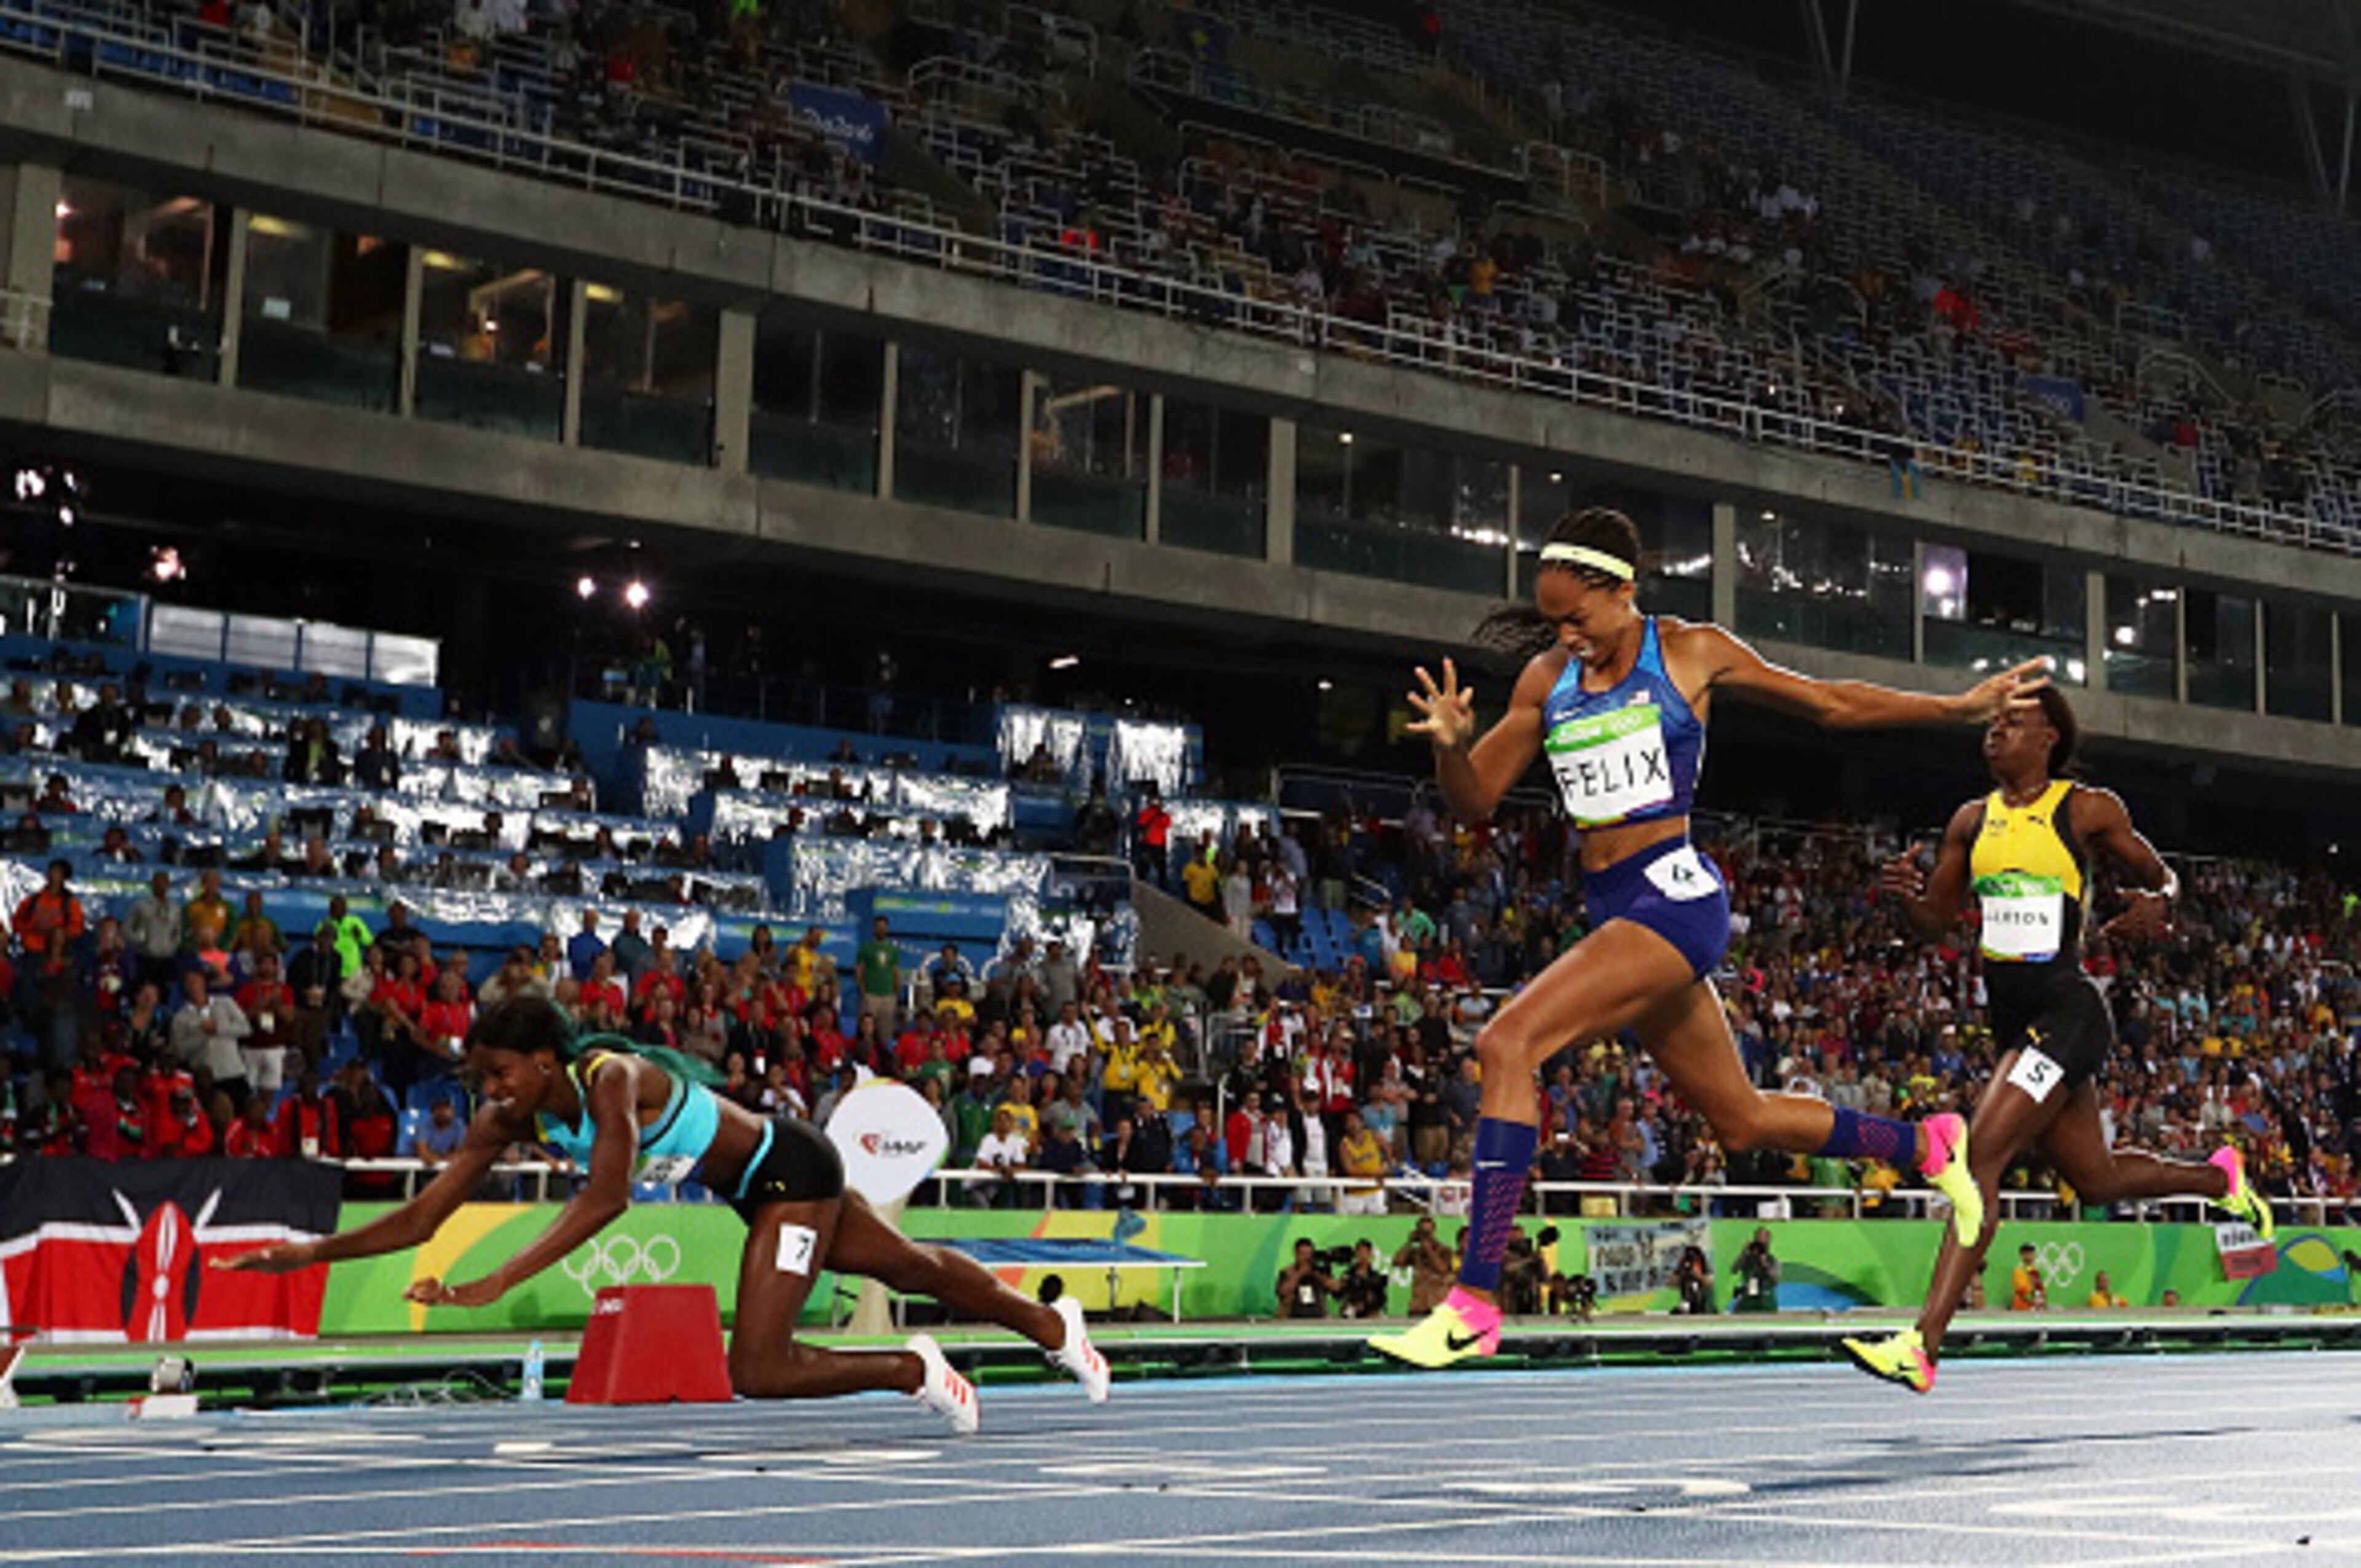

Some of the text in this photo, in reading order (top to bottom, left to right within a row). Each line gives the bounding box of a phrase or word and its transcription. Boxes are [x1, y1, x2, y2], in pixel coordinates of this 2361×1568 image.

[1556, 747, 1666, 800] FELIX
[1672, 864, 1695, 884] 4
[2027, 1061, 2052, 1087] 5
[796, 1234, 810, 1259] 7
